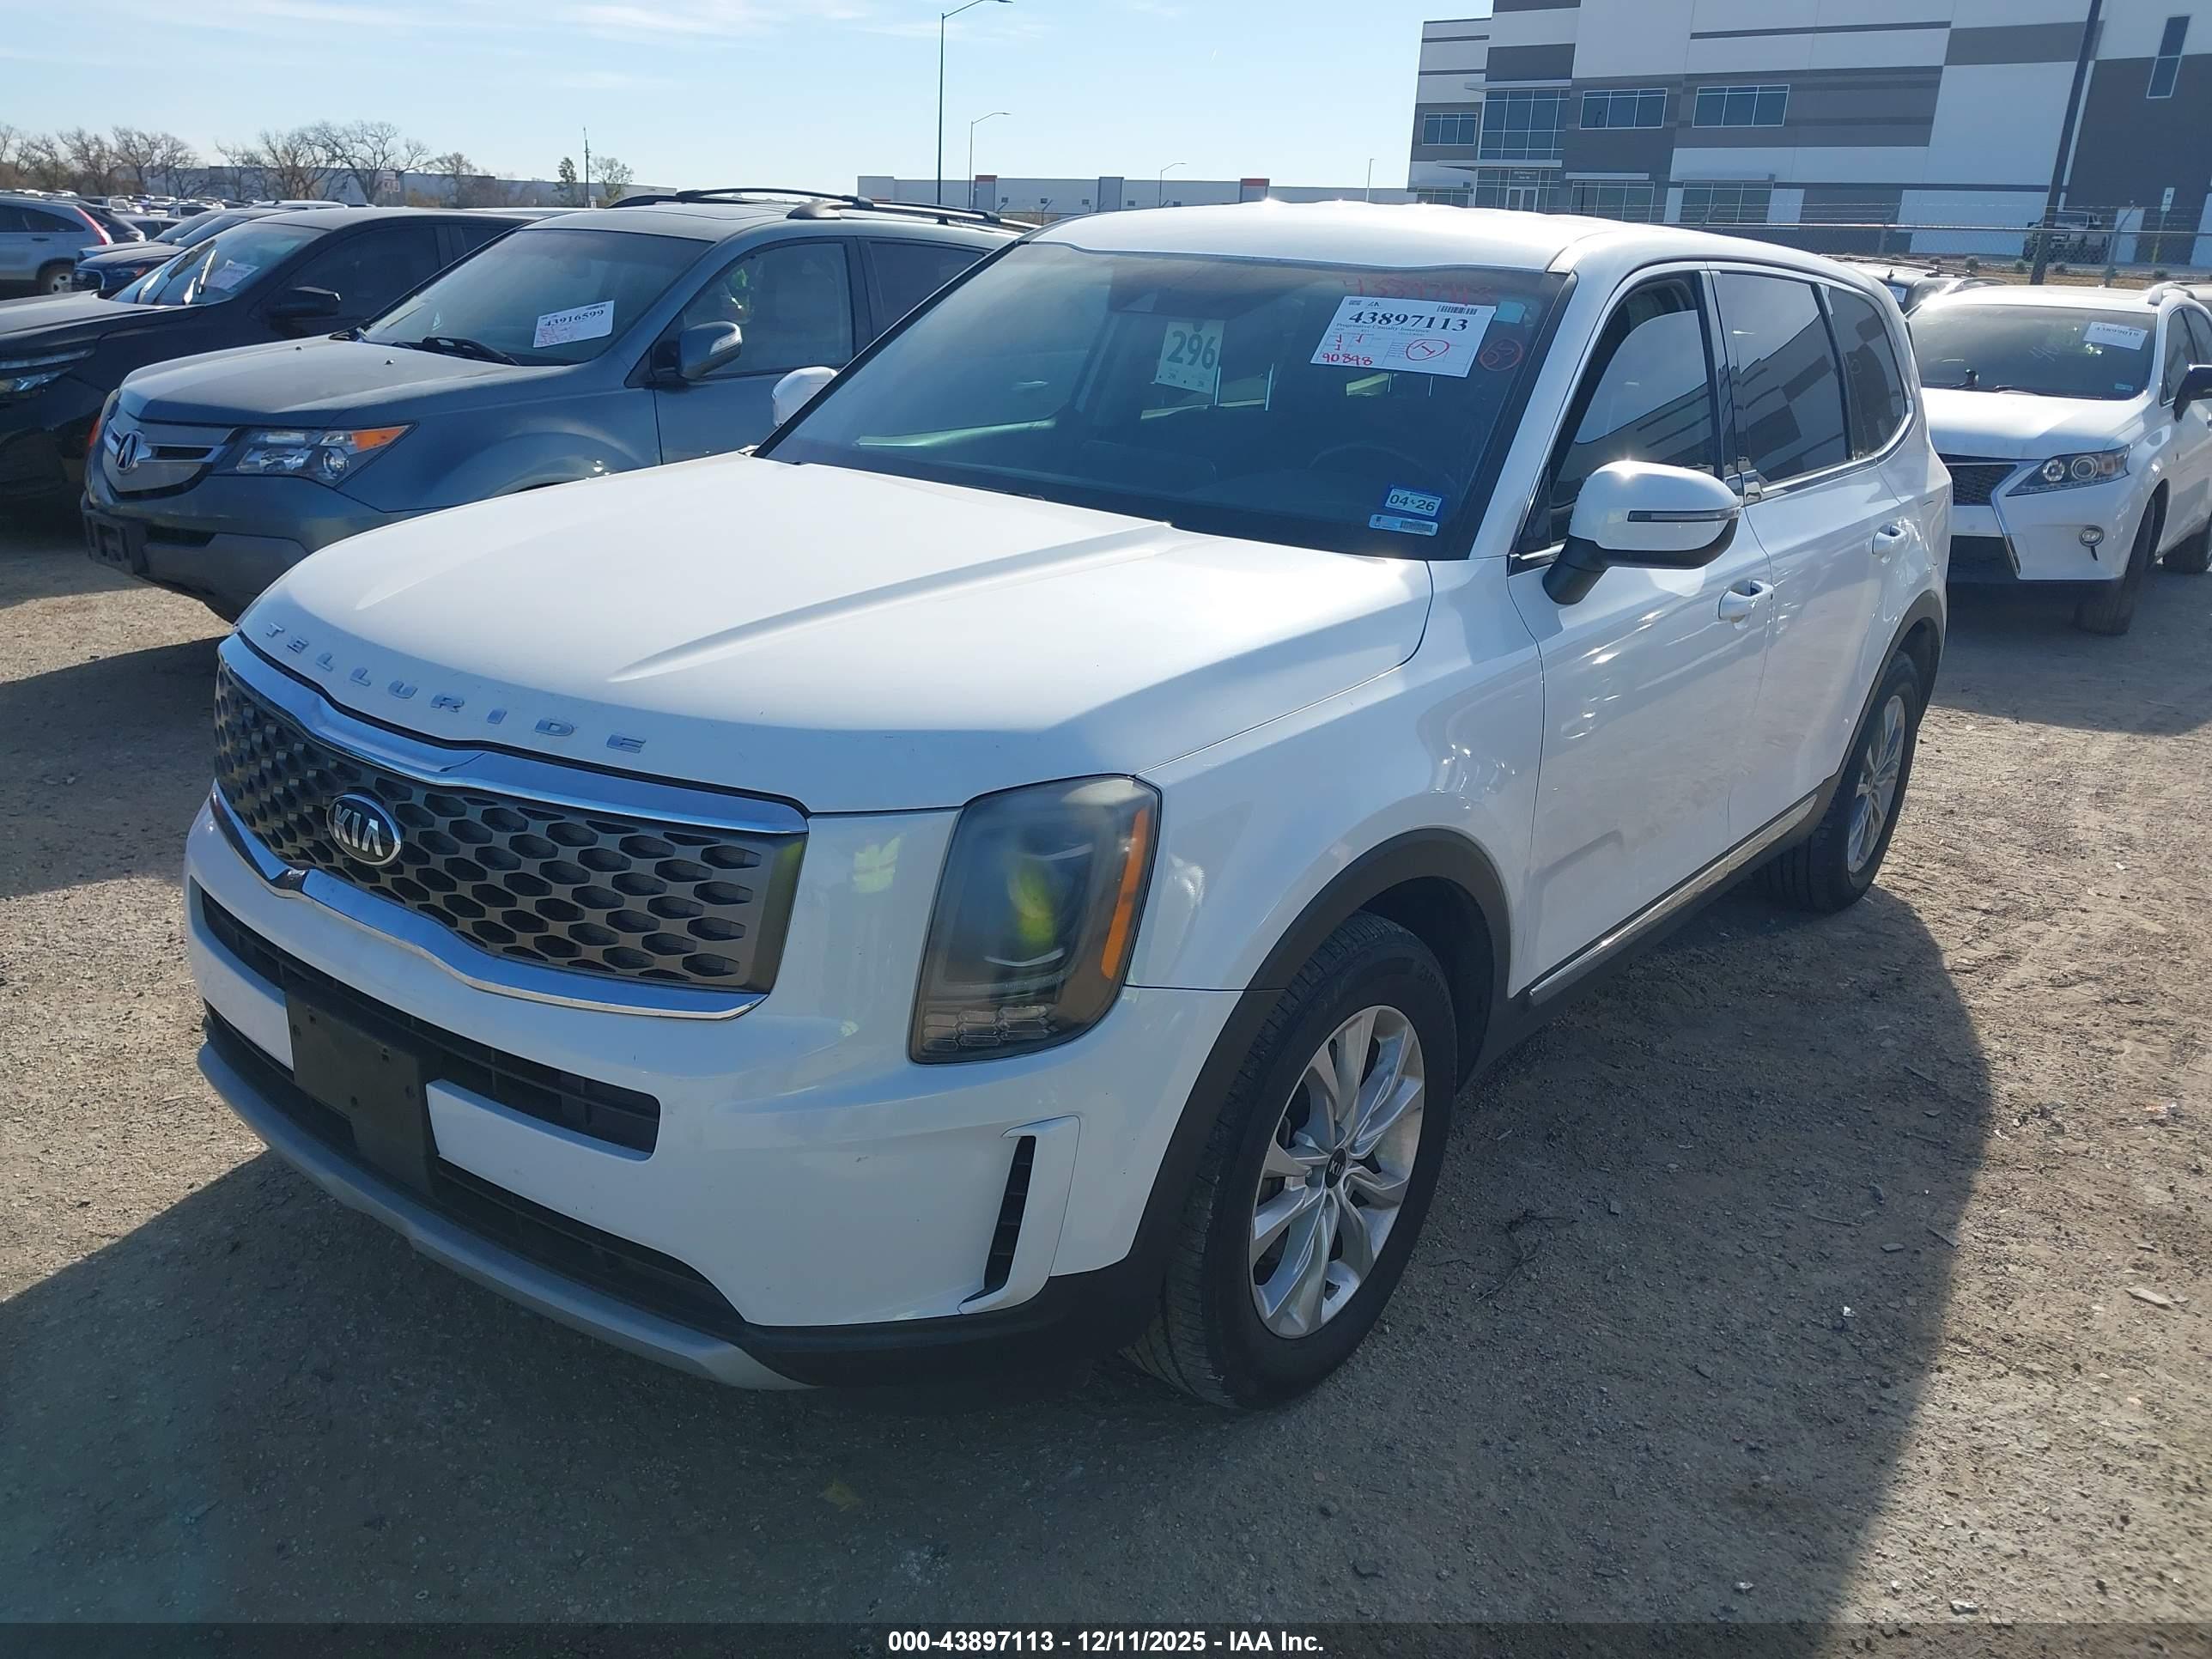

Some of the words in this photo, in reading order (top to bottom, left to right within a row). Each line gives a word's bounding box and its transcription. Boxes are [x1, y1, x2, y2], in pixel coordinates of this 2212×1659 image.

[1348, 310, 1468, 331] 43897113
[1166, 330, 1217, 370] 296
[1322, 353, 1373, 366] 90898
[266, 621, 647, 754] TELLURIDE
[334, 804, 384, 857] KIA
